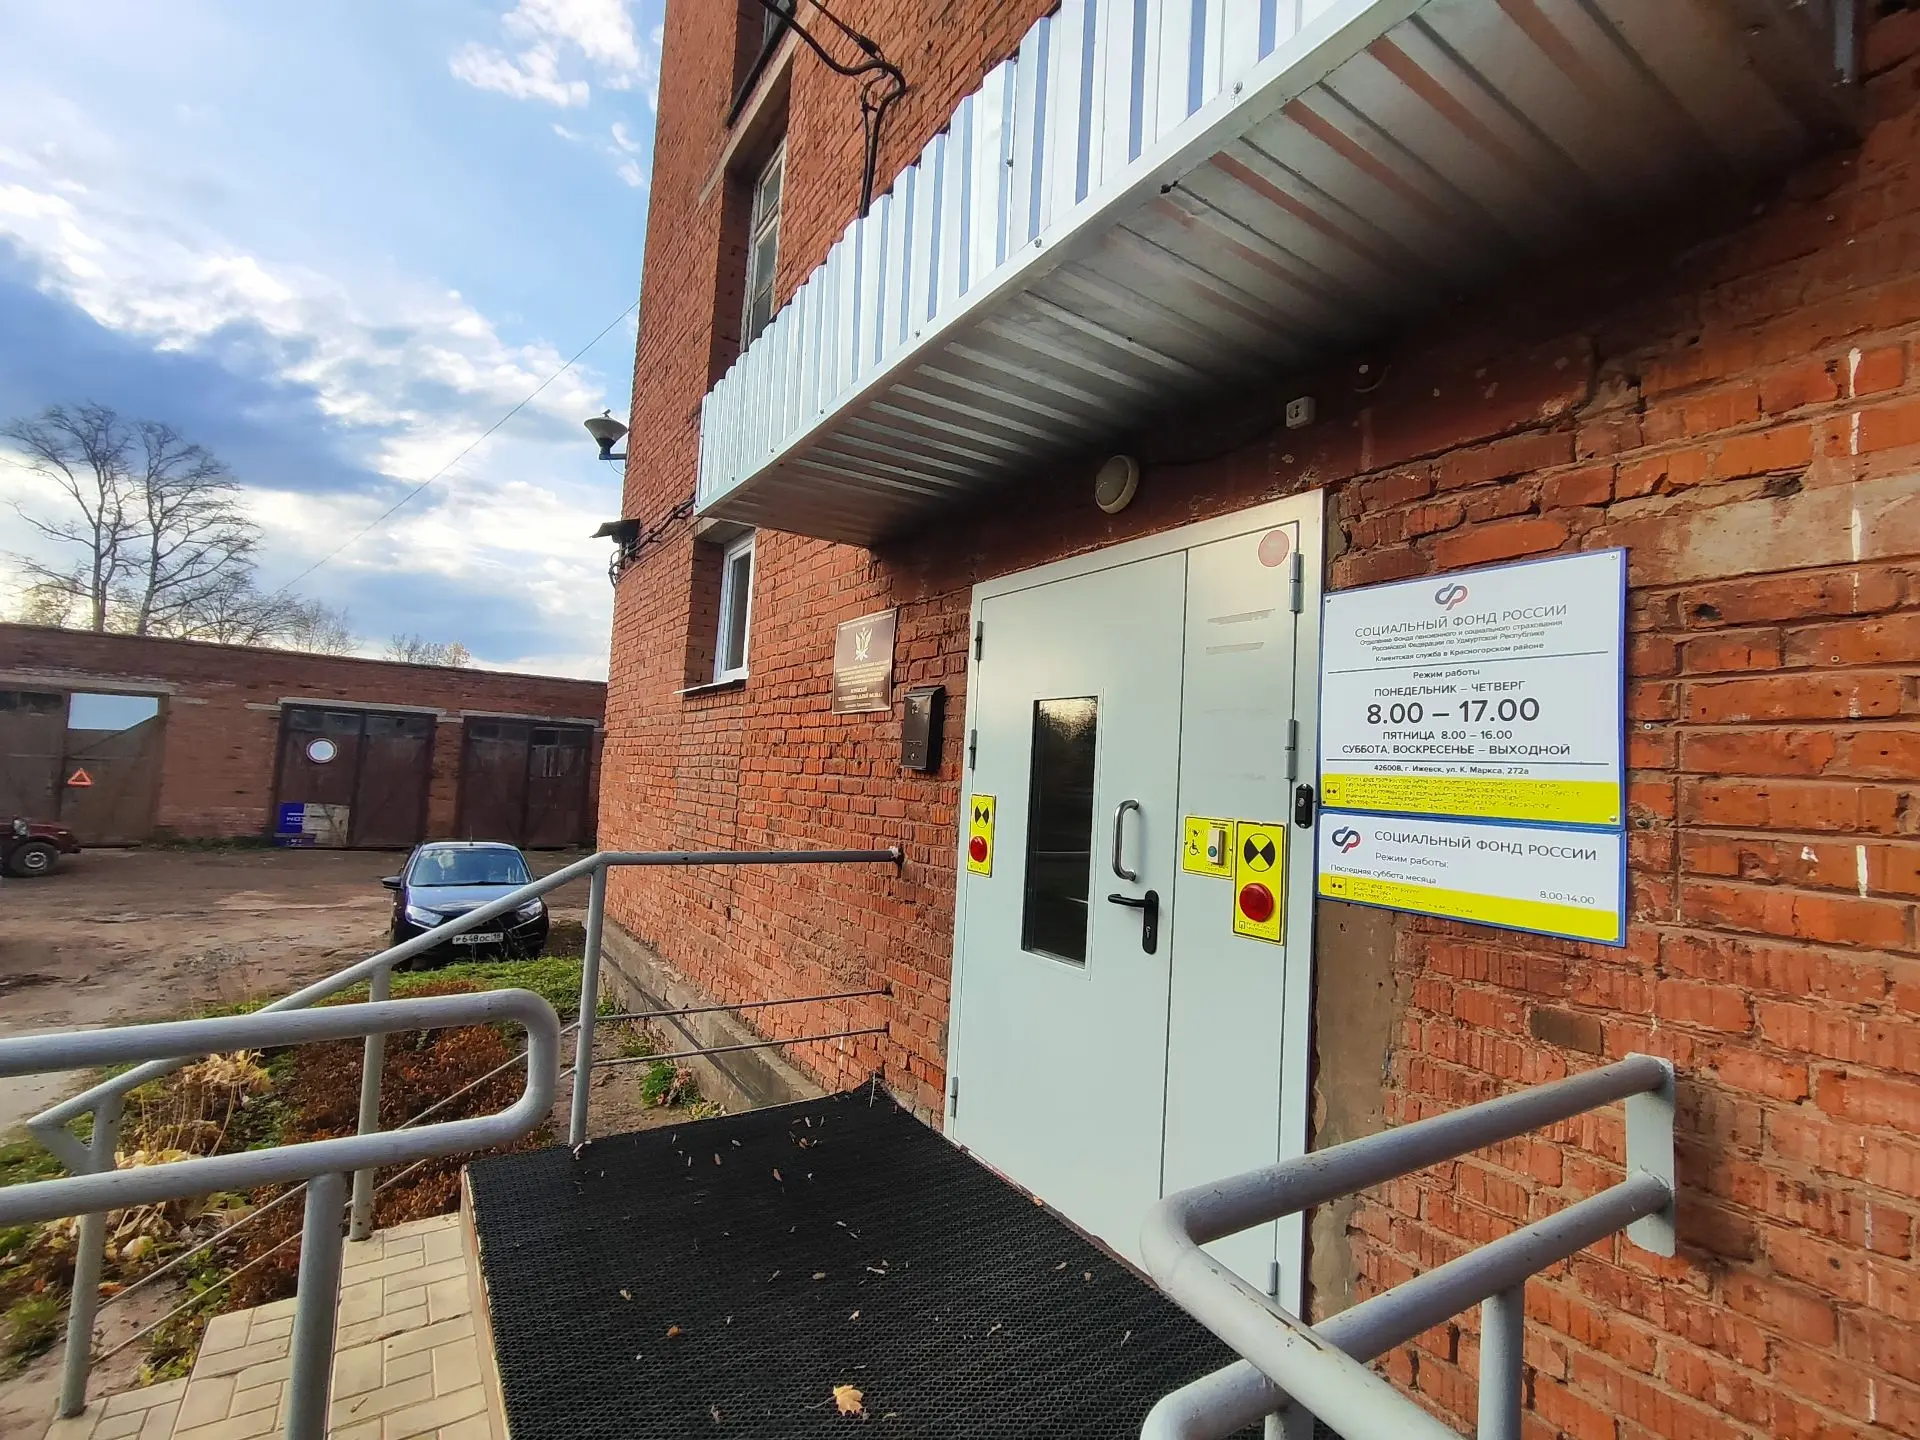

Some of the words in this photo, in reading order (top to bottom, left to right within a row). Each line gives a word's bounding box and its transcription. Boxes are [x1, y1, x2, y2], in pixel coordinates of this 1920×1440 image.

[1355, 616, 1447, 637] СОЦИАЛЬНЫЙ
[1453, 612, 1497, 626] ФОНД
[1503, 604, 1567, 621] РОССИИ
[1513, 620, 1563, 630] страхования
[1375, 654, 1414, 662] Клиентская
[1415, 650, 1441, 660] служба
[1450, 645, 1511, 656] Красногорском
[1513, 642, 1544, 652] районе
[1413, 671, 1443, 679] Режим
[1445, 669, 1480, 678] работы
[1374, 684, 1457, 697] ПОНЕДЕЛЬНИК
[1471, 680, 1526, 693] ЧЕТВЕРГ
[1366, 702, 1424, 725] 8.00
[1458, 697, 1540, 723] 17.00
[1382, 730, 1436, 741] ПЯТНИЦА
[1440, 730, 1467, 740] 8.00
[1480, 730, 1513, 740] 16.00
[1341, 744, 1391, 755] СУББОТА,
[1392, 744, 1475, 755] ВОСКРЕСЕНЬЕ
[1489, 743, 1571, 756] ВЫХОДНОЙ
[1469, 766, 1505, 775] Маркса,
[1374, 830, 1471, 849] СОЦИАЛЬНЫЙ
[1476, 839, 1523, 856] ФОНД
[1528, 844, 1597, 861] РОССИИ
[1375, 852, 1408, 863] Режим
[1409, 856, 1449, 869] работы:
[1330, 864, 1371, 875] Последняя
[1372, 869, 1404, 880] суббота
[1405, 875, 1437, 885] месяца
[1539, 890, 1595, 905] 8.00-14.00
